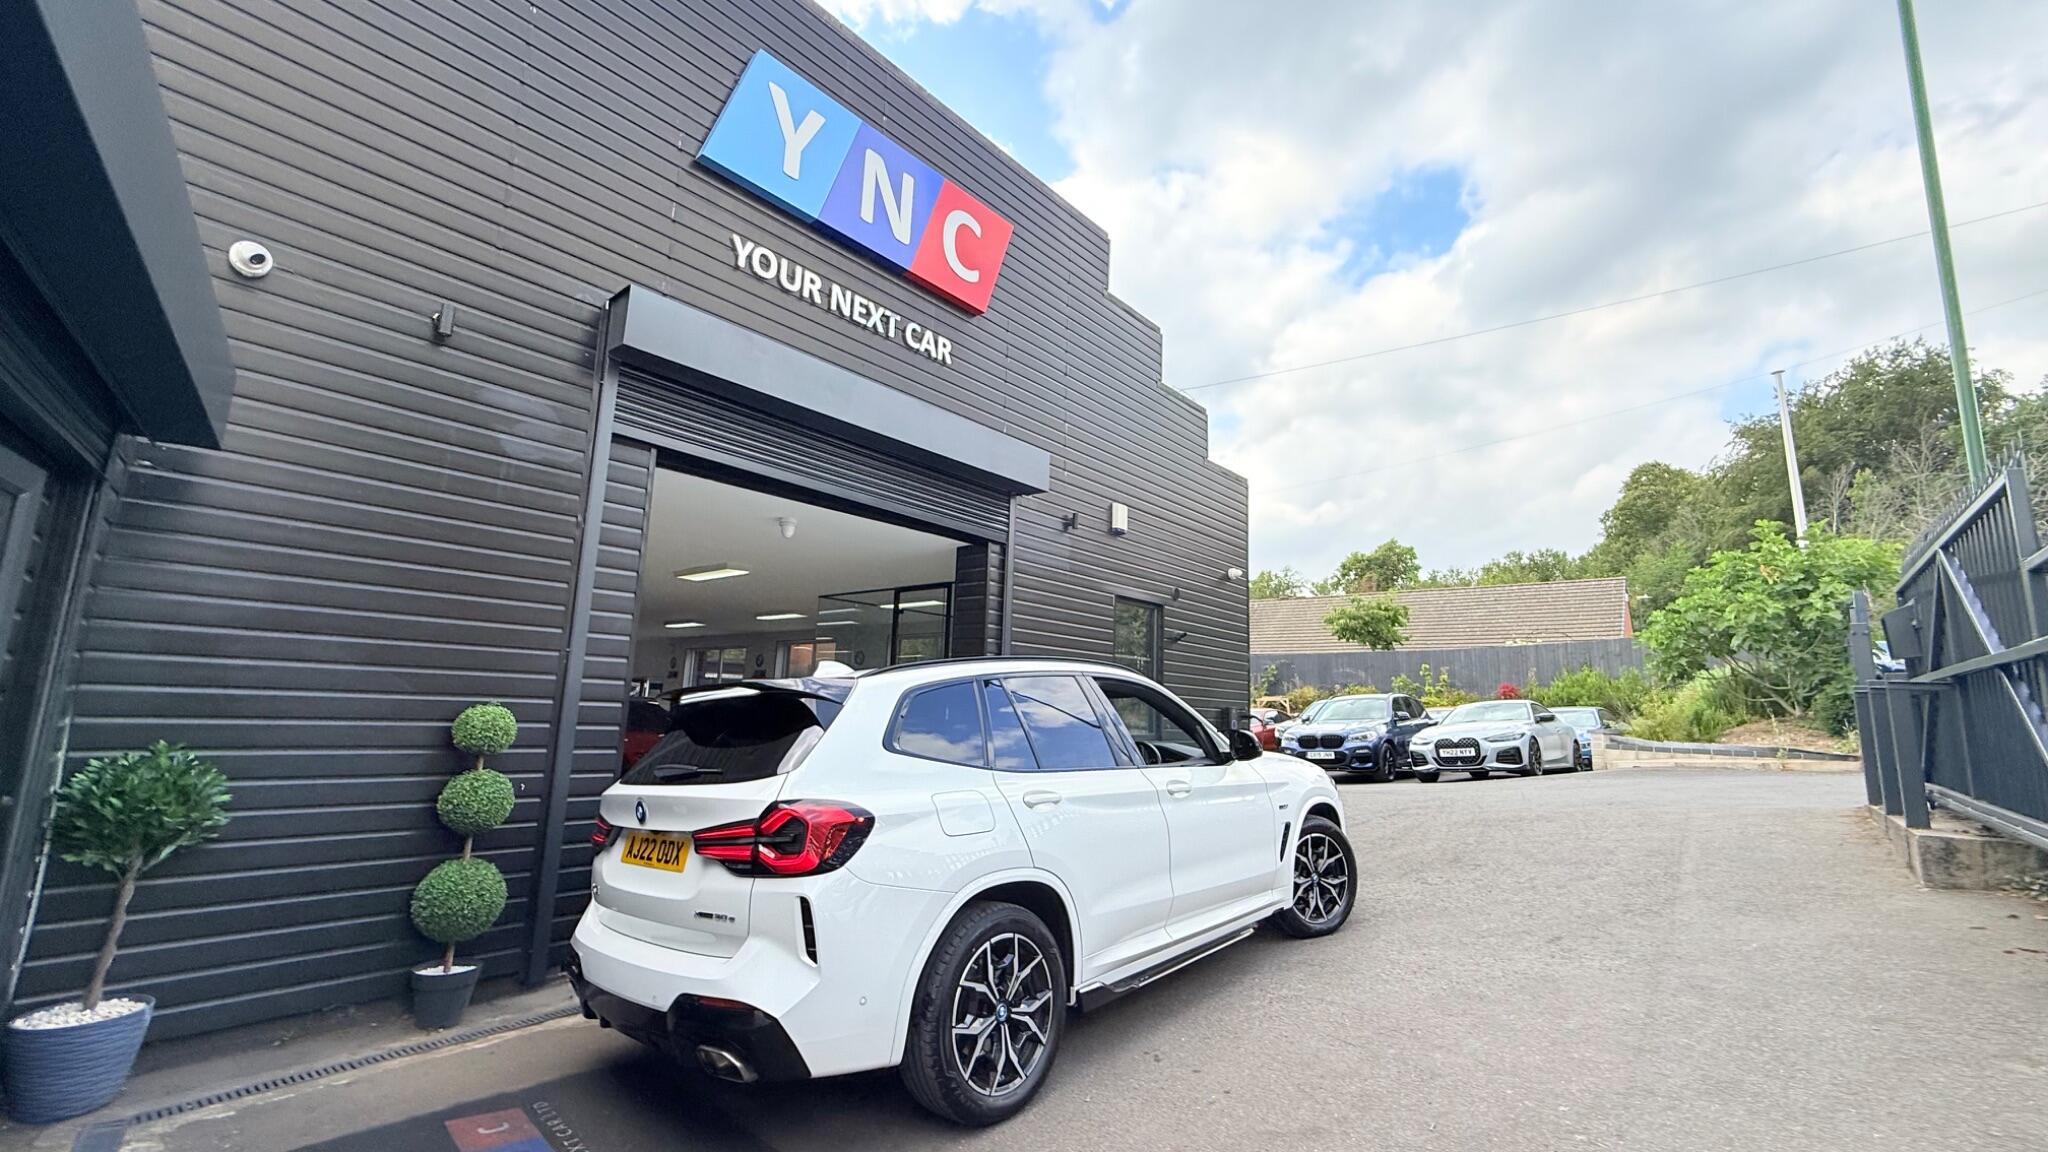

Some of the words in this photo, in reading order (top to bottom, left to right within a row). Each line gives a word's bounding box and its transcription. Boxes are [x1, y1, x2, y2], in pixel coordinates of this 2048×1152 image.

[768, 81, 982, 283] YNC
[731, 233, 822, 305] YOUR
[830, 283, 901, 338] NEXT
[904, 321, 952, 364] CAR
[626, 836, 657, 861] AJ22
[656, 840, 685, 866] ODX
[547, 1117, 572, 1138] CAR
